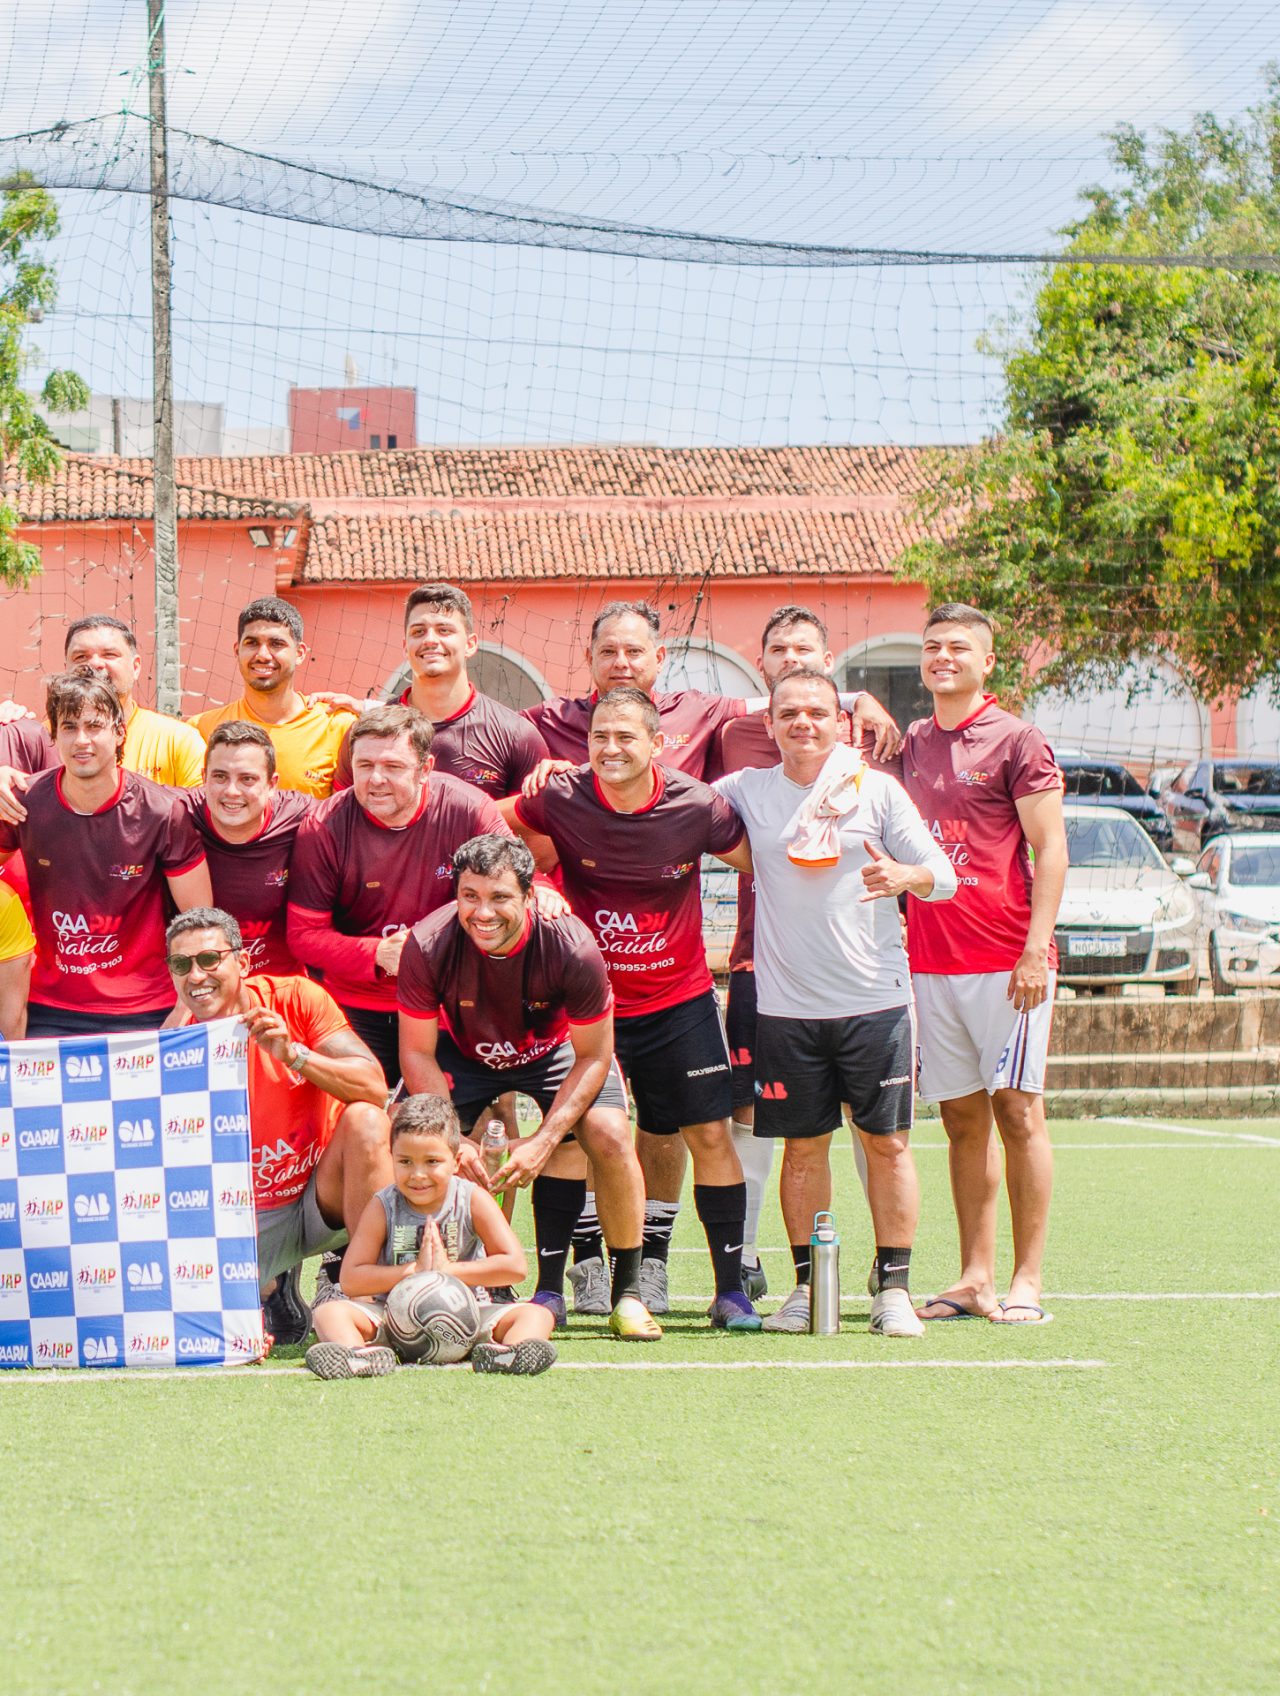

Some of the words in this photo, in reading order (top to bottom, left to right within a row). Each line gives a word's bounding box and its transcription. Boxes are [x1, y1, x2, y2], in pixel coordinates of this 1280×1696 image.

[612, 957, 675, 972] 99952-9103
[65, 1055, 103, 1077] OAB
[163, 1047, 205, 1068] CAARN
[19, 1128, 59, 1147] CAARN
[118, 1118, 155, 1142] OAB
[74, 1192, 111, 1217] OAB
[169, 1190, 209, 1209] CAARN
[30, 1270, 68, 1289] CAARN
[127, 1261, 164, 1285] OAB
[83, 1335, 119, 1359] OAB
[178, 1337, 220, 1354] CAARN
